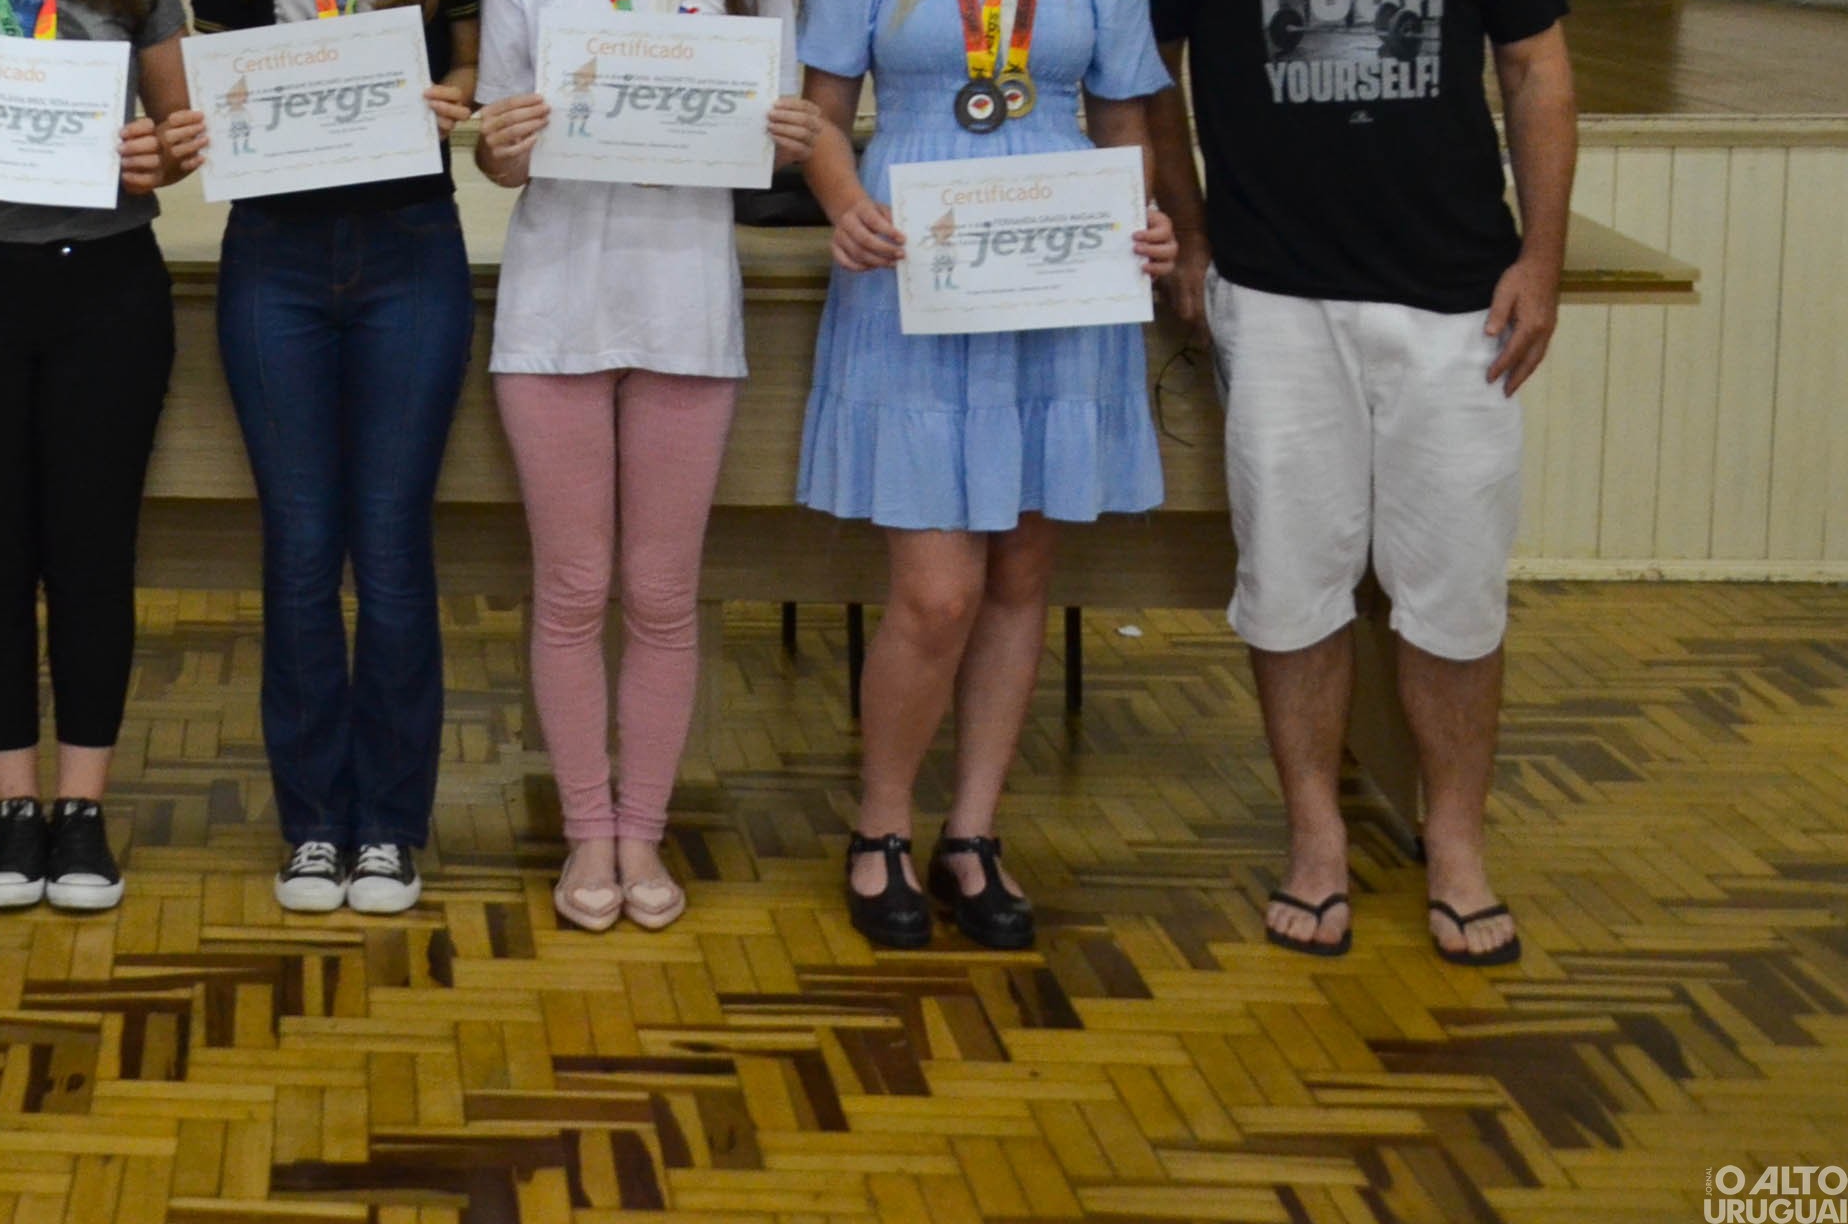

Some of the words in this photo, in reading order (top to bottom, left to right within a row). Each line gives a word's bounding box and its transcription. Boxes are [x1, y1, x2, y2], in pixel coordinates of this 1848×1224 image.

[233, 46, 340, 74] Certificado
[586, 37, 695, 60] Certificado
[605, 74, 746, 124] jergs
[1264, 55, 1440, 104] YOURSELF!
[265, 80, 400, 131] jergs
[940, 183, 1053, 206] Certificado
[969, 221, 1114, 268] jergs
